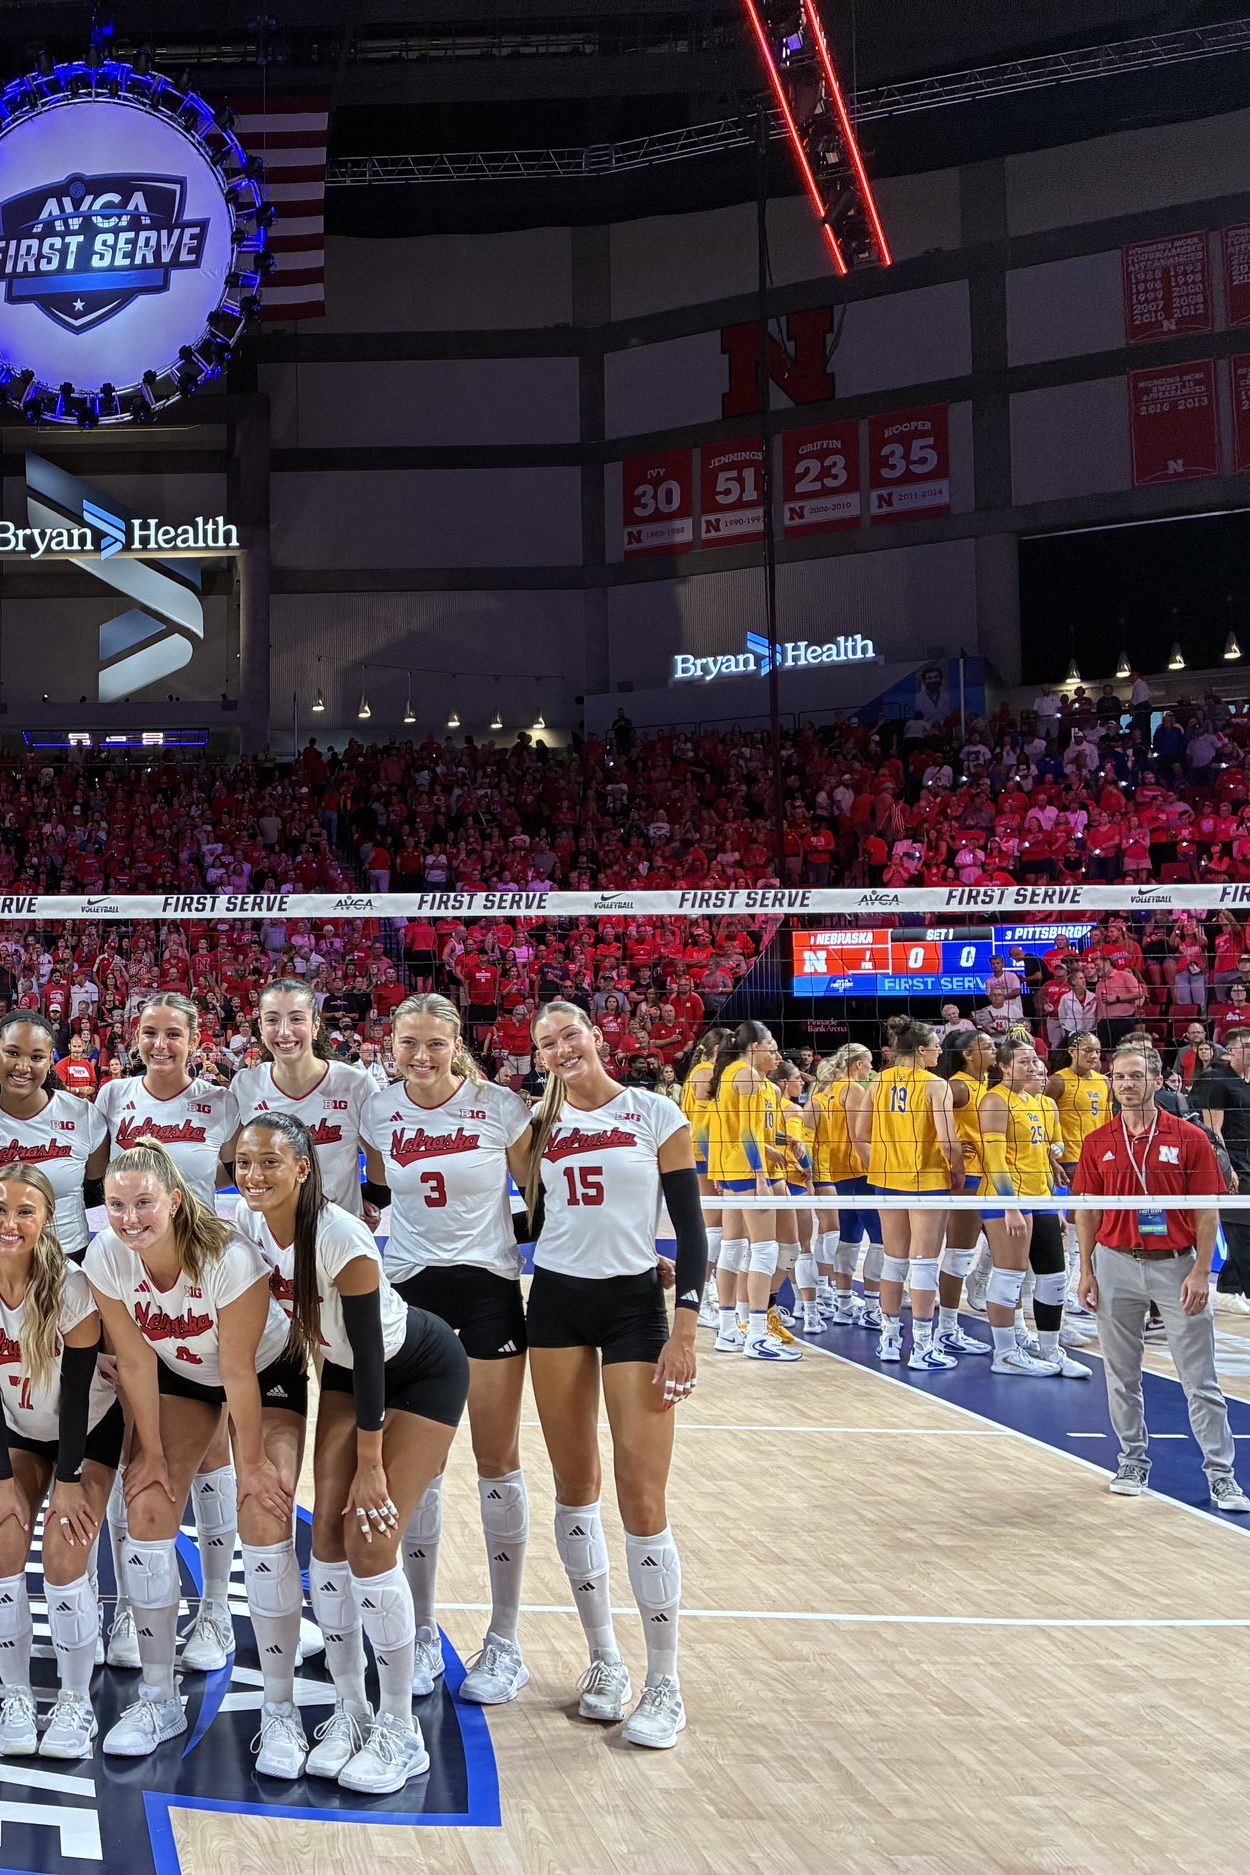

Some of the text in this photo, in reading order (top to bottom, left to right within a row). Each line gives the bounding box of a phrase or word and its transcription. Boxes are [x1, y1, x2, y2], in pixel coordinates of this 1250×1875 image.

[32, 191, 152, 233] AVCA
[91, 226, 200, 268] SERVE
[720, 305, 836, 419] N
[884, 420, 932, 438] HOOPER
[799, 440, 842, 454] GRIFFIN
[709, 451, 763, 469] JENNINGS
[880, 437, 938, 479] 35
[1166, 459, 1183, 474] N
[647, 468, 666, 479] IVY
[794, 455, 848, 494] 23
[715, 467, 758, 505] 51
[633, 480, 681, 517] 30
[876, 492, 893, 509] N
[788, 505, 806, 522] N
[131, 516, 240, 549] Health
[704, 518, 722, 534] N
[626, 530, 643, 545] N
[674, 634, 876, 681] Bryan Health
[81, 905, 120, 913] VOLLEYBALL
[161, 896, 218, 912] FIRST
[225, 895, 290, 912] SERVE
[331, 896, 377, 910] AVCA
[417, 893, 478, 911] FIRST
[483, 892, 549, 910] SERVE
[593, 901, 634, 909] VOLLEYBALL
[678, 891, 741, 909] FIRST
[744, 890, 812, 908] SERVE
[856, 891, 902, 906] AVCA
[945, 888, 1009, 906] FIRST
[1013, 887, 1084, 905] SERVE
[1130, 895, 1172, 903] VOLLEYBALL
[816, 932, 873, 945] NEBRASKA
[926, 929, 947, 941] SET
[1005, 931, 1013, 940] 3
[803, 950, 827, 973] N
[908, 948, 925, 968] 0
[960, 946, 976, 967] 0
[884, 976, 935, 990] FIRST
[891, 1084, 908, 1113] 19
[1090, 1100, 1099, 1116] 5
[117, 1116, 206, 1143] Nebraska
[1030, 1125, 1043, 1144] 25
[391, 1127, 481, 1155] Nebraska
[1158, 1144, 1180, 1165] N
[420, 1171, 447, 1208] 3
[563, 1166, 604, 1206] 15
